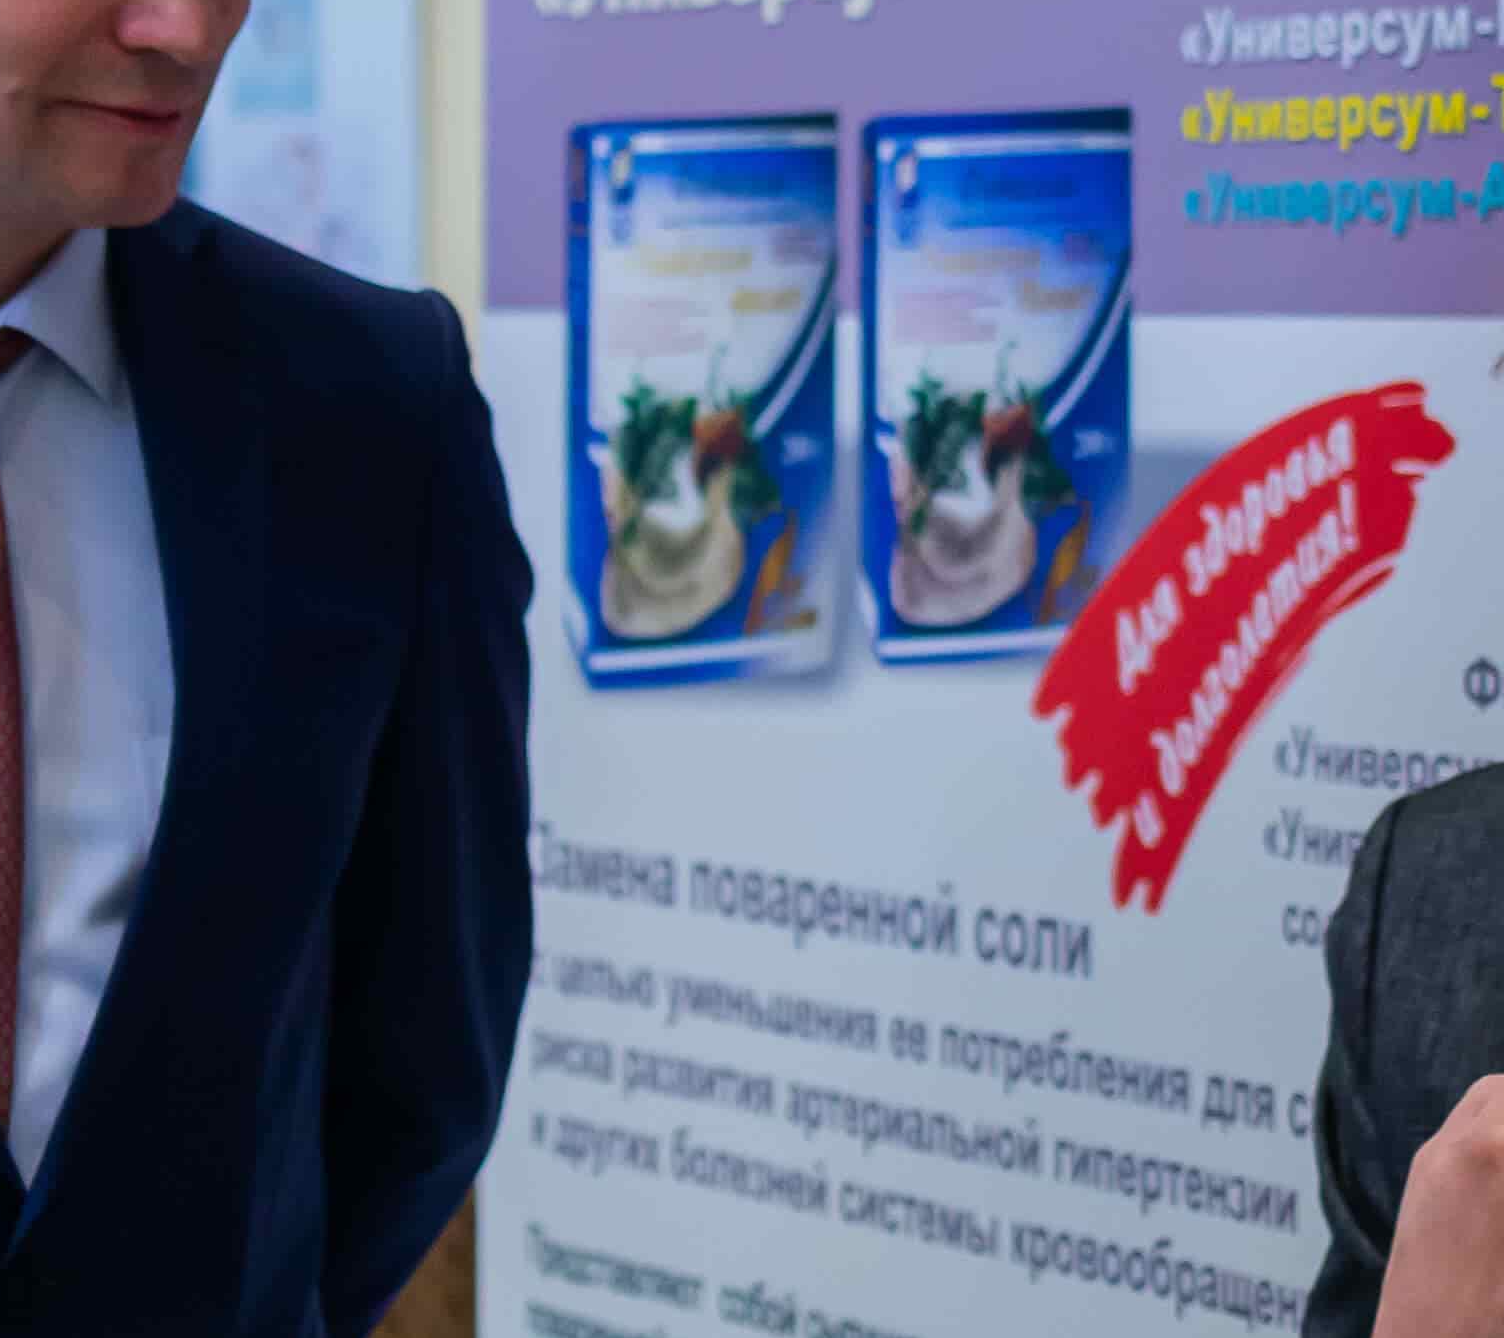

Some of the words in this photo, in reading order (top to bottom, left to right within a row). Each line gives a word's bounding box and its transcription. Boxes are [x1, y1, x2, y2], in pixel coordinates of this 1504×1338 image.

[1114, 573, 1184, 696] Для
[1184, 417, 1356, 597] здоровья
[1131, 794, 1166, 851] и
[1149, 483, 1359, 797] долголетия!
[690, 857, 960, 957] поваренной
[975, 907, 1093, 978] соли
[531, 1028, 615, 1085] риска
[621, 1046, 775, 1115] развития
[787, 1081, 1041, 1175] артериальной
[1054, 1137, 1299, 1233] гипертензии
[552, 954, 658, 1011] целью
[665, 974, 879, 1053] уменьшения
[889, 1016, 930, 1064] ее
[942, 1025, 1191, 1113] потребления
[1202, 1074, 1276, 1136] для
[532, 1111, 549, 1149] и
[553, 1114, 662, 1177] других
[669, 1124, 830, 1212] болезней
[839, 1181, 998, 1255] системы
[1012, 1221, 1308, 1330] кровообращен
[719, 1281, 796, 1336] собой
